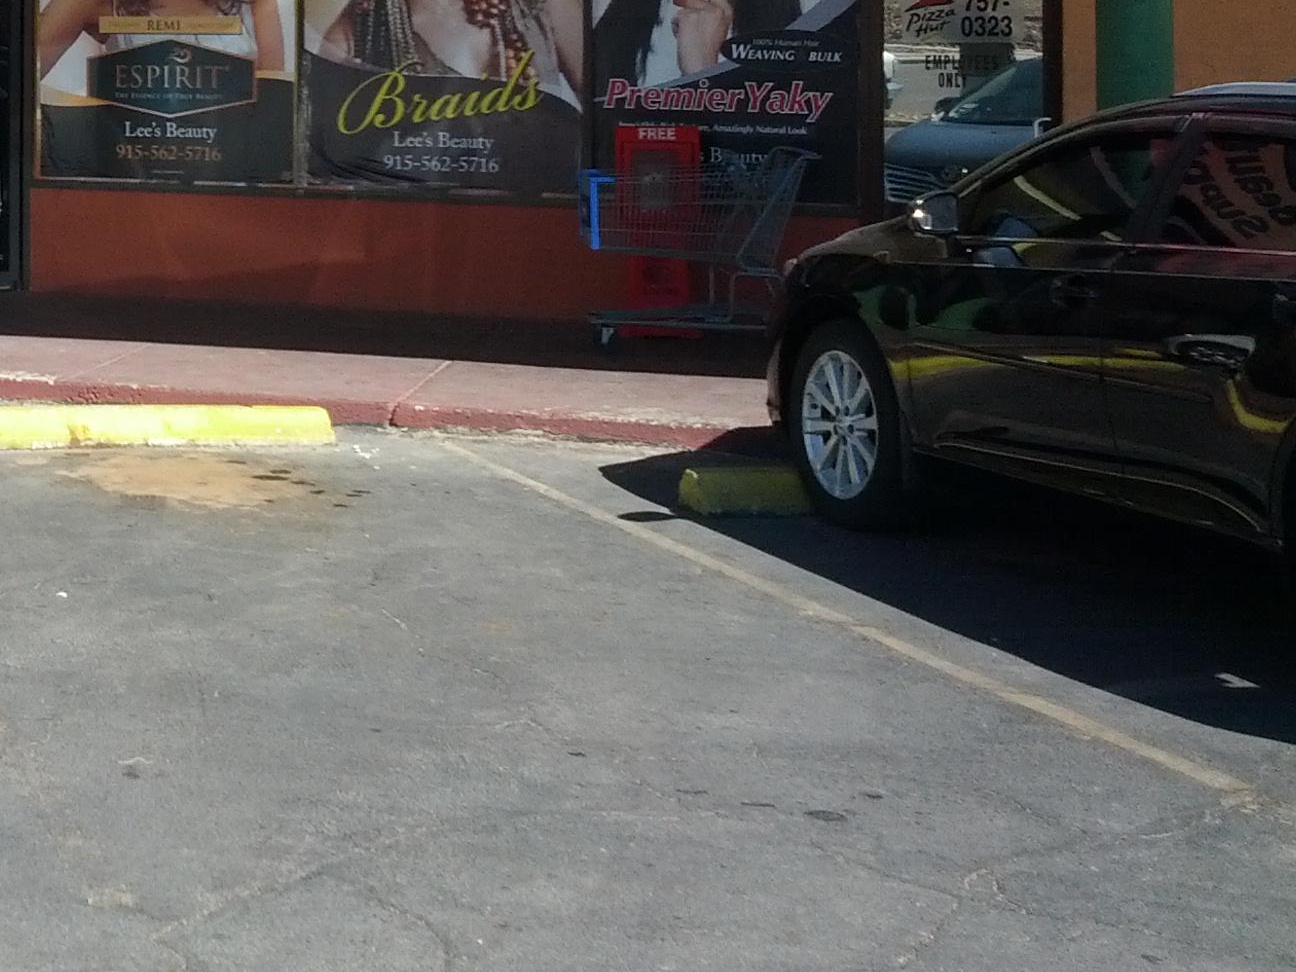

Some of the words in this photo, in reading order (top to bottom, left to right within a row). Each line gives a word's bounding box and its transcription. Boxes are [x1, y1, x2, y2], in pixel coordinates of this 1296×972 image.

[147, 19, 181, 31] REMI
[906, 8, 956, 32] Pizza
[915, 21, 952, 38] Hut
[960, 15, 1013, 37] 0323
[808, 51, 842, 62] BULK
[115, 64, 224, 89] ESPIRIT
[938, 72, 967, 88] ONLY
[338, 49, 544, 135] Braids
[124, 121, 161, 138] Lee's
[165, 122, 217, 143] Beauty
[638, 127, 676, 140] FREE
[393, 130, 433, 148] Lee's
[438, 132, 494, 154] Beauty
[115, 144, 222, 161] 915-562-5716
[384, 154, 500, 173] 915-562-5716
